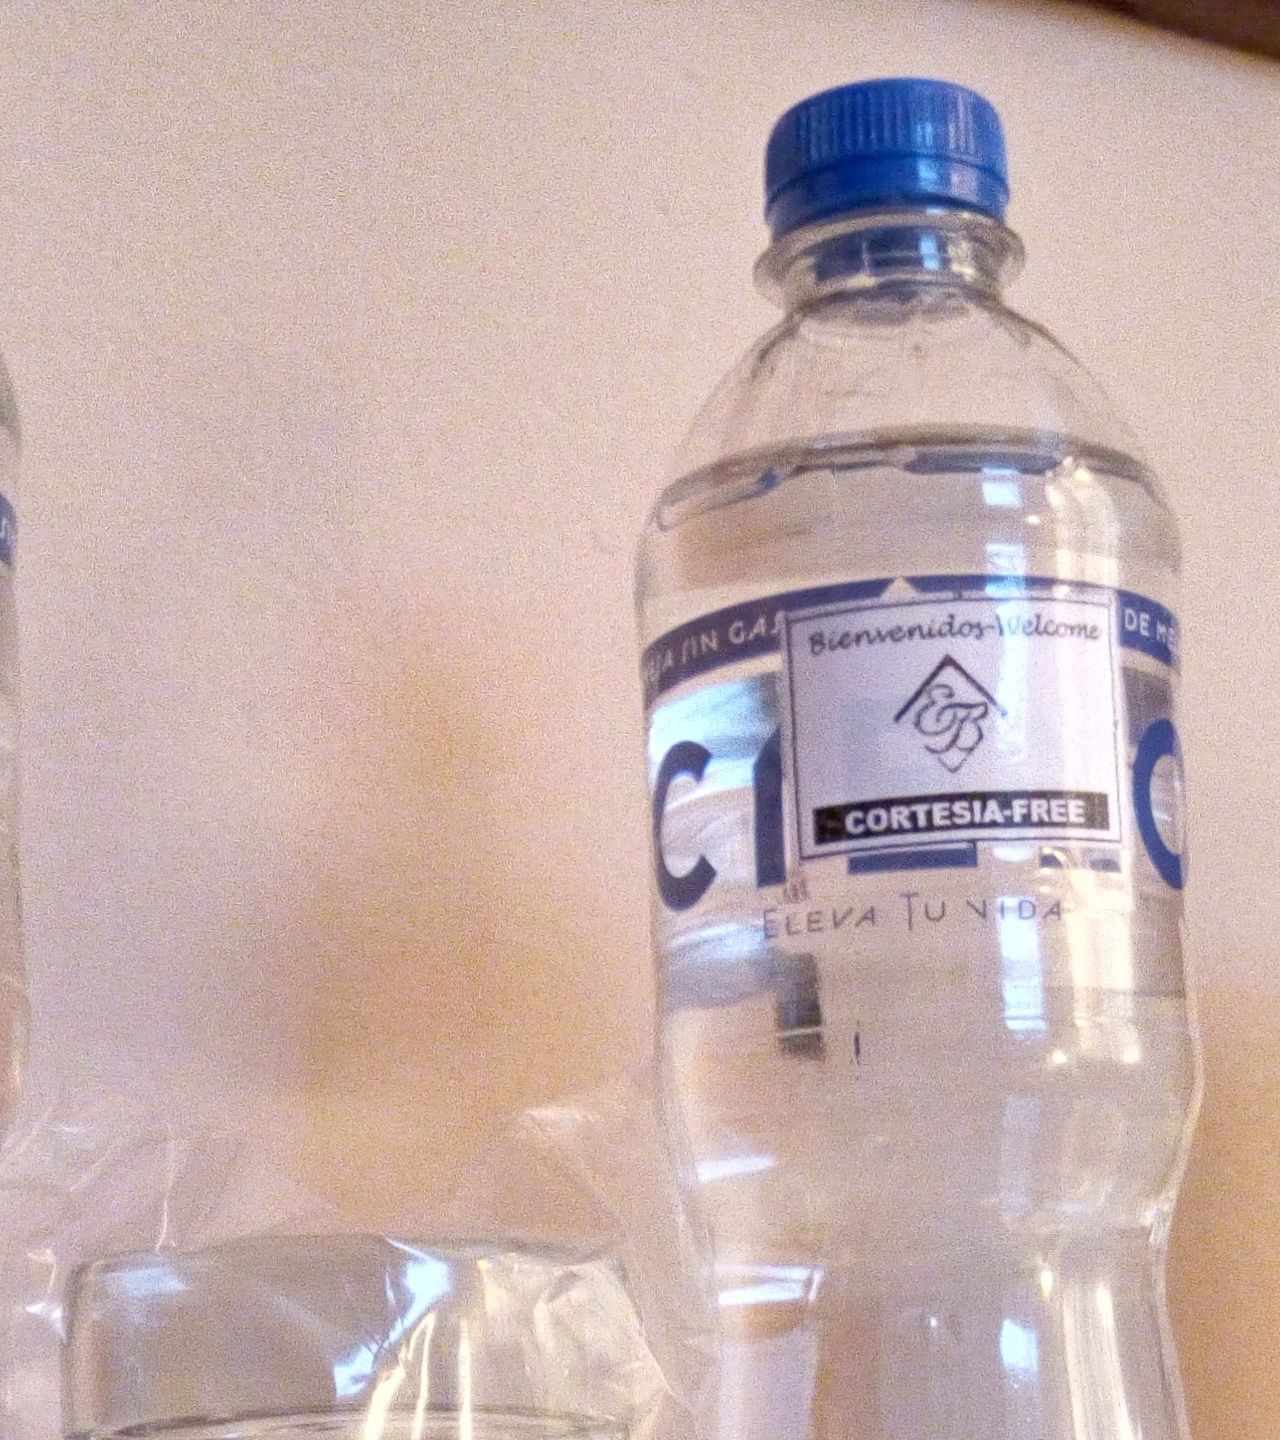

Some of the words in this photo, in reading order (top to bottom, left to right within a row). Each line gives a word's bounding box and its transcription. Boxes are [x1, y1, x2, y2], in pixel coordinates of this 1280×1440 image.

[1123, 607, 1151, 637] DE
[844, 798, 1086, 836] CORTESIA-FREE
[762, 904, 877, 940] ELEVA
[898, 891, 946, 932] TU
[965, 898, 1063, 922] VIDA
